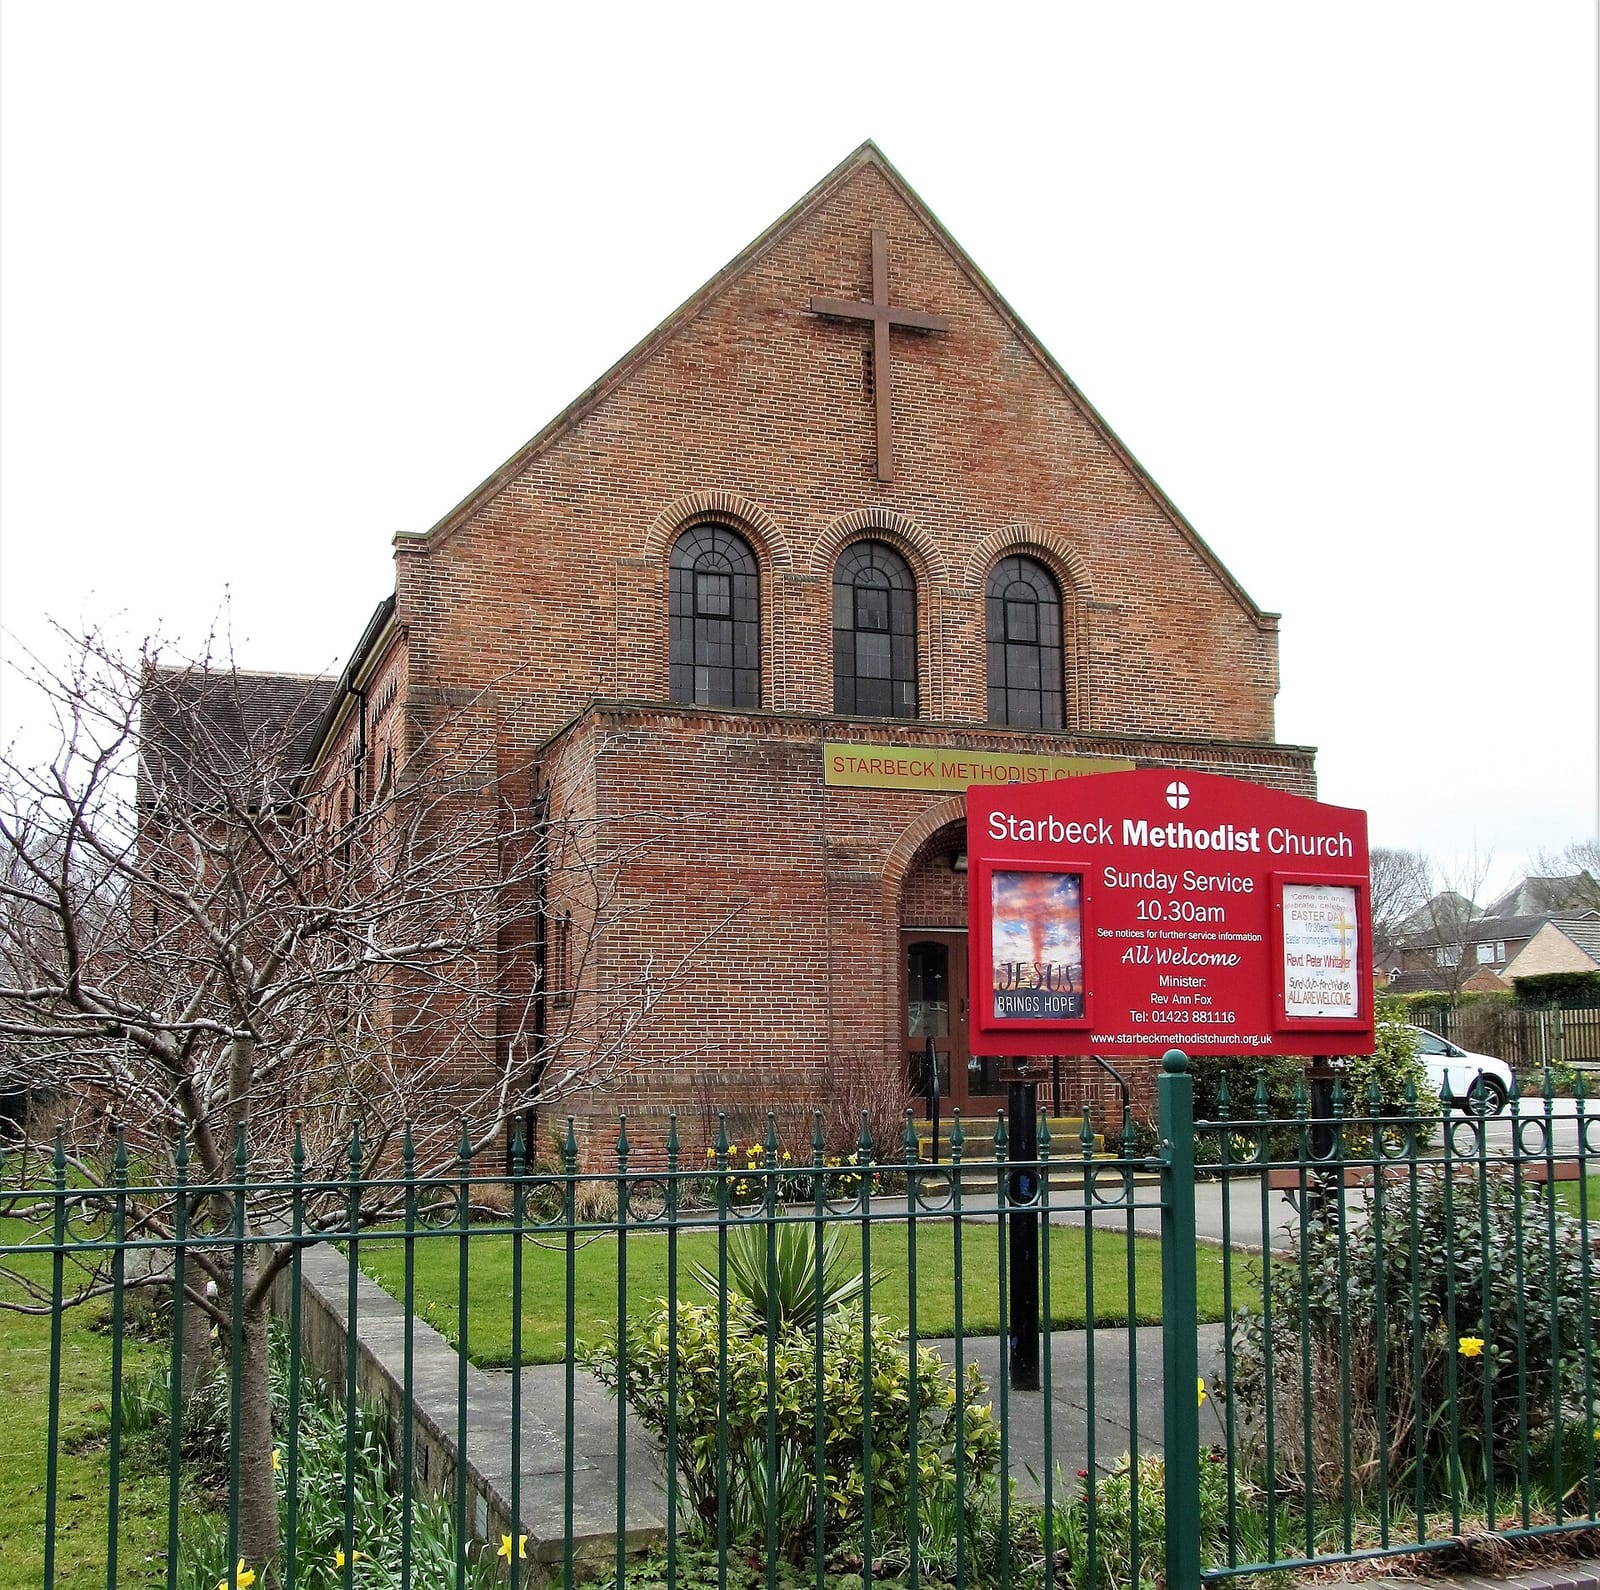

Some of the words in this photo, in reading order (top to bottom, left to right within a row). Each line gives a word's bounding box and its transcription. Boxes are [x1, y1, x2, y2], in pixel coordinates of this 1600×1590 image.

[832, 756, 936, 777] STARBECK
[941, 762, 1049, 782] METHODIST
[988, 811, 1115, 845] Starbeck
[1122, 819, 1261, 853] Methodist
[1267, 827, 1353, 857] Church
[1103, 866, 1178, 894] Sunday
[1183, 870, 1254, 893] Service
[1136, 899, 1226, 922] 10.30am
[1291, 911, 1325, 921] EASTER
[1097, 928, 1113, 938] See
[1115, 928, 1145, 939] notices
[1146, 928, 1157, 939] for
[1159, 930, 1186, 940] further
[1188, 931, 1217, 940] service
[1218, 931, 1262, 942] information
[1121, 945, 1154, 965] All
[1155, 946, 1241, 967] Welcome
[1306, 954, 1322, 967] Peter
[999, 961, 1074, 993] JESUS
[1159, 975, 1207, 988] Minister:
[998, 996, 1040, 1012] BRINGS
[1044, 996, 1075, 1012] HOPE
[1150, 993, 1169, 1005] Rev
[1172, 993, 1192, 1005] Ann
[1194, 994, 1212, 1005] Fox
[1288, 991, 1303, 1004] ALL
[1303, 992, 1316, 1005] ARE
[1316, 992, 1352, 1006] WELCOME
[1130, 1010, 1149, 1022] Tel:
[1152, 1010, 1189, 1023] 01423
[1192, 1011, 1236, 1023] 881116
[1090, 1032, 1272, 1046] www.starbeckmethodistchurch.org.uk
